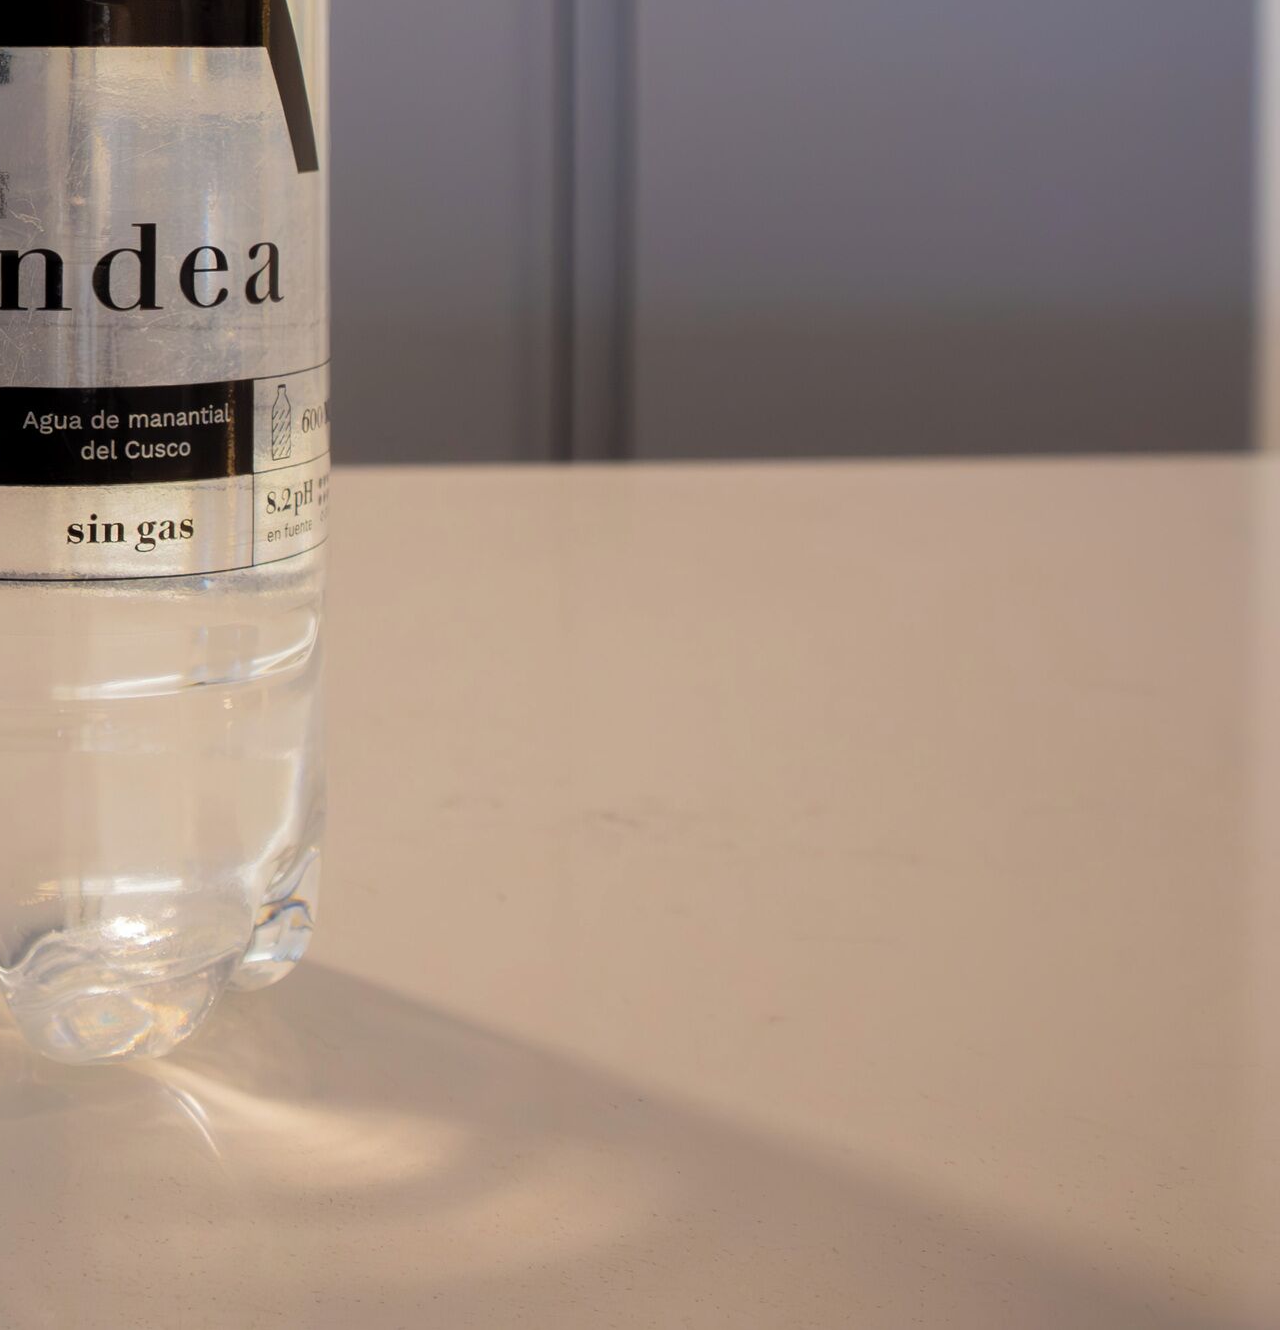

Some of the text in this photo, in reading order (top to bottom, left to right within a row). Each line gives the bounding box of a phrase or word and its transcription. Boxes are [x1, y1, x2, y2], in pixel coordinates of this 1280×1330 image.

[23, 404, 232, 435] Agua de manantial
[80, 438, 192, 461] del Cusco
[66, 513, 195, 553] sin gas
[267, 518, 313, 542] en fuente
